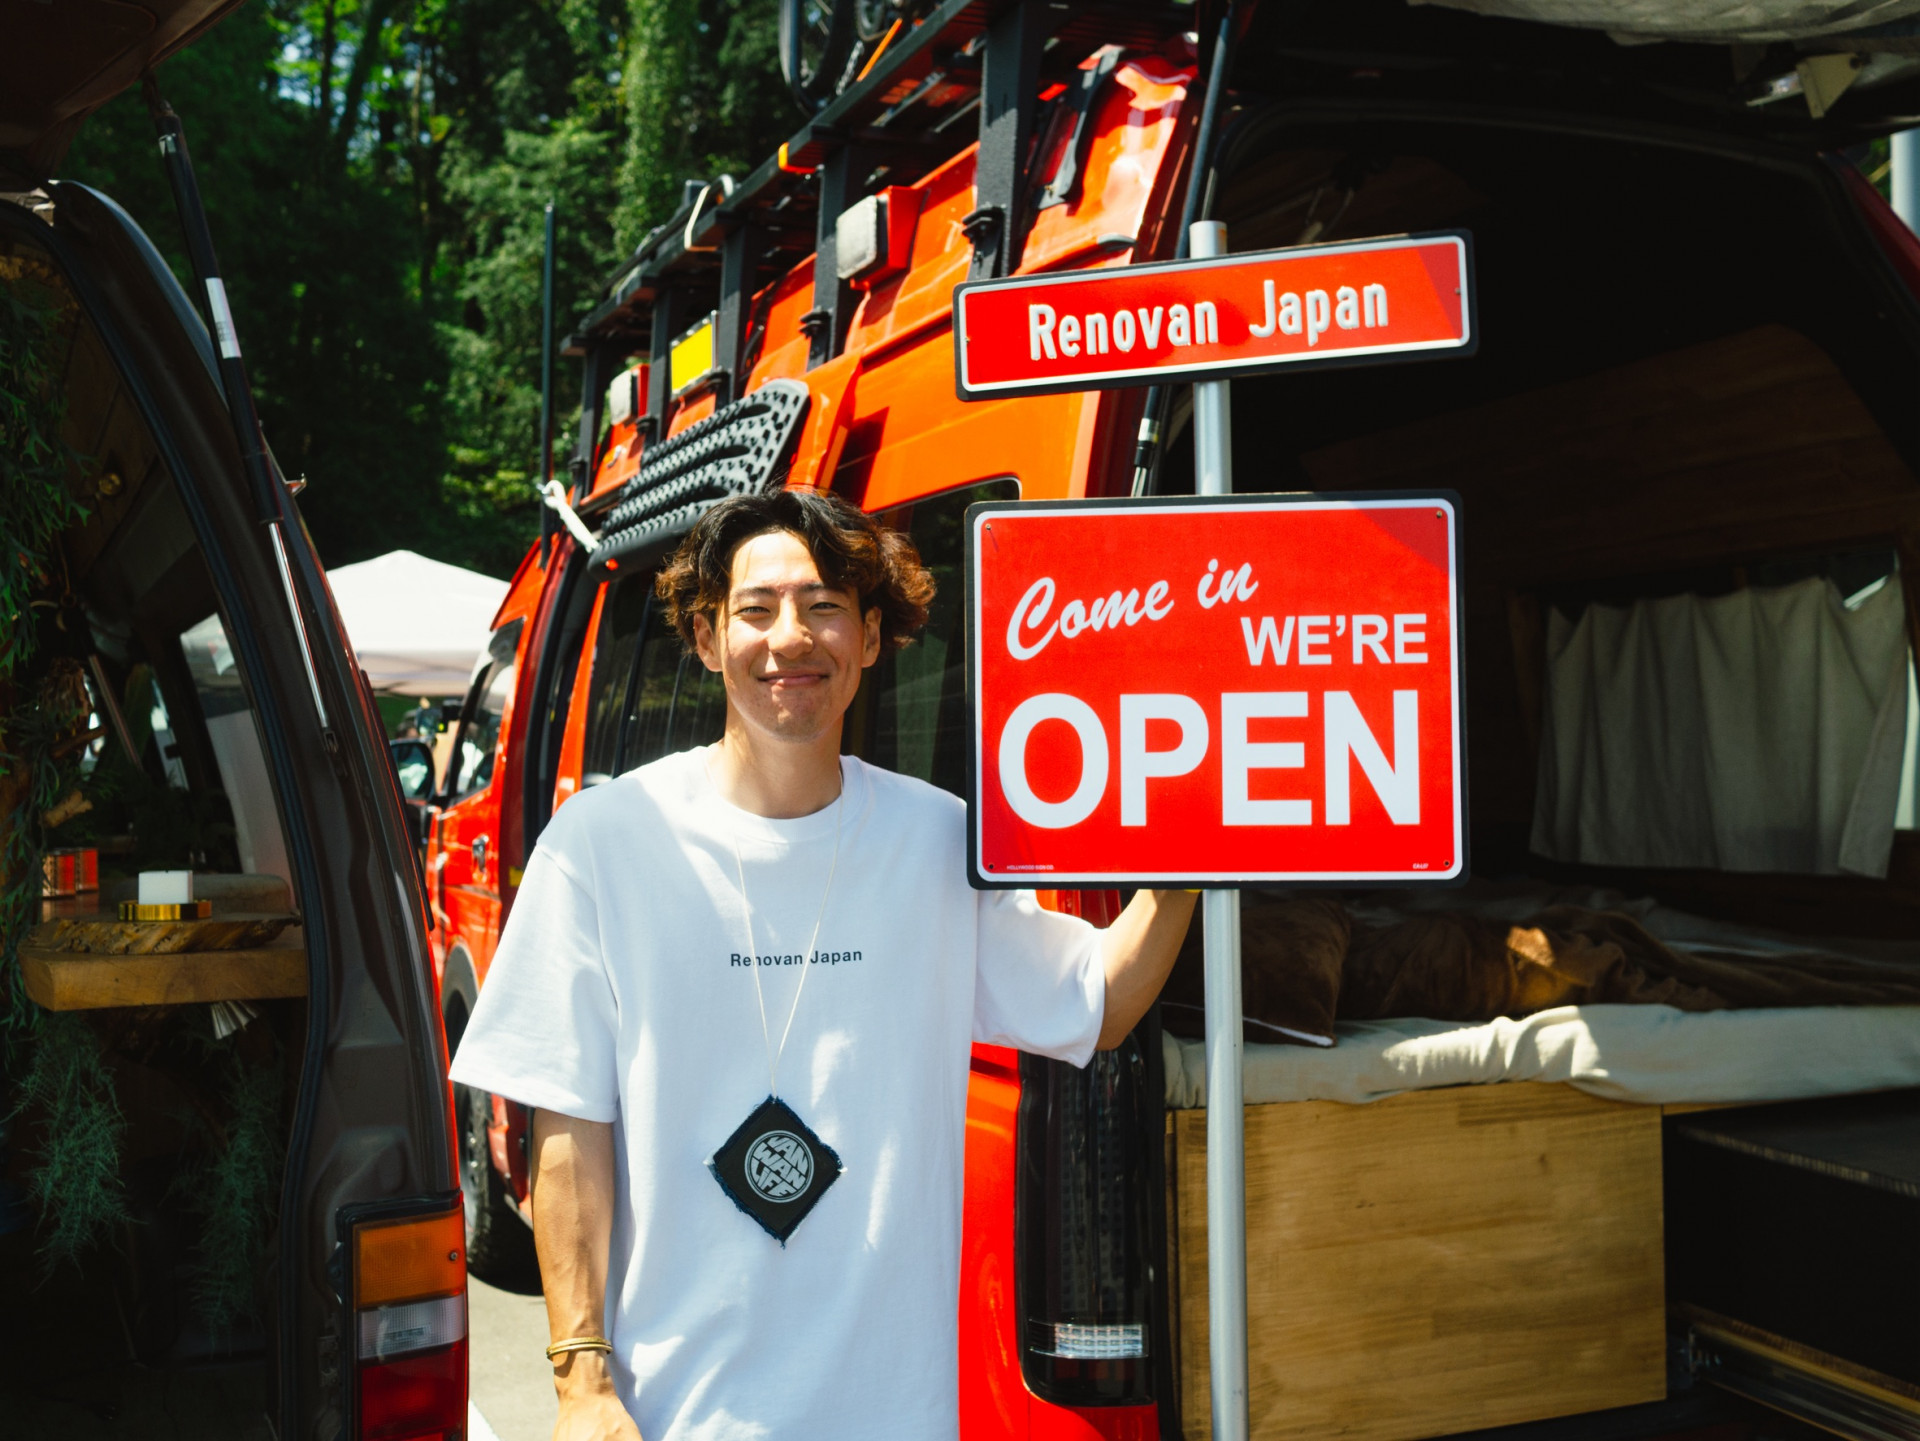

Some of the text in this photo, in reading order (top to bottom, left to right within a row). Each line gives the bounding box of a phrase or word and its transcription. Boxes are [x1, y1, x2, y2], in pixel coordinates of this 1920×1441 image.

[1029, 279, 1389, 361] Renovan Japan
[1006, 558, 1259, 661] Come in
[1241, 613, 1429, 666] WE'RE
[998, 689, 1421, 829] OPEN
[730, 950, 863, 967] Renovan Japan
[750, 1157, 797, 1197] LIFE
[766, 1136, 809, 1176] VAN
